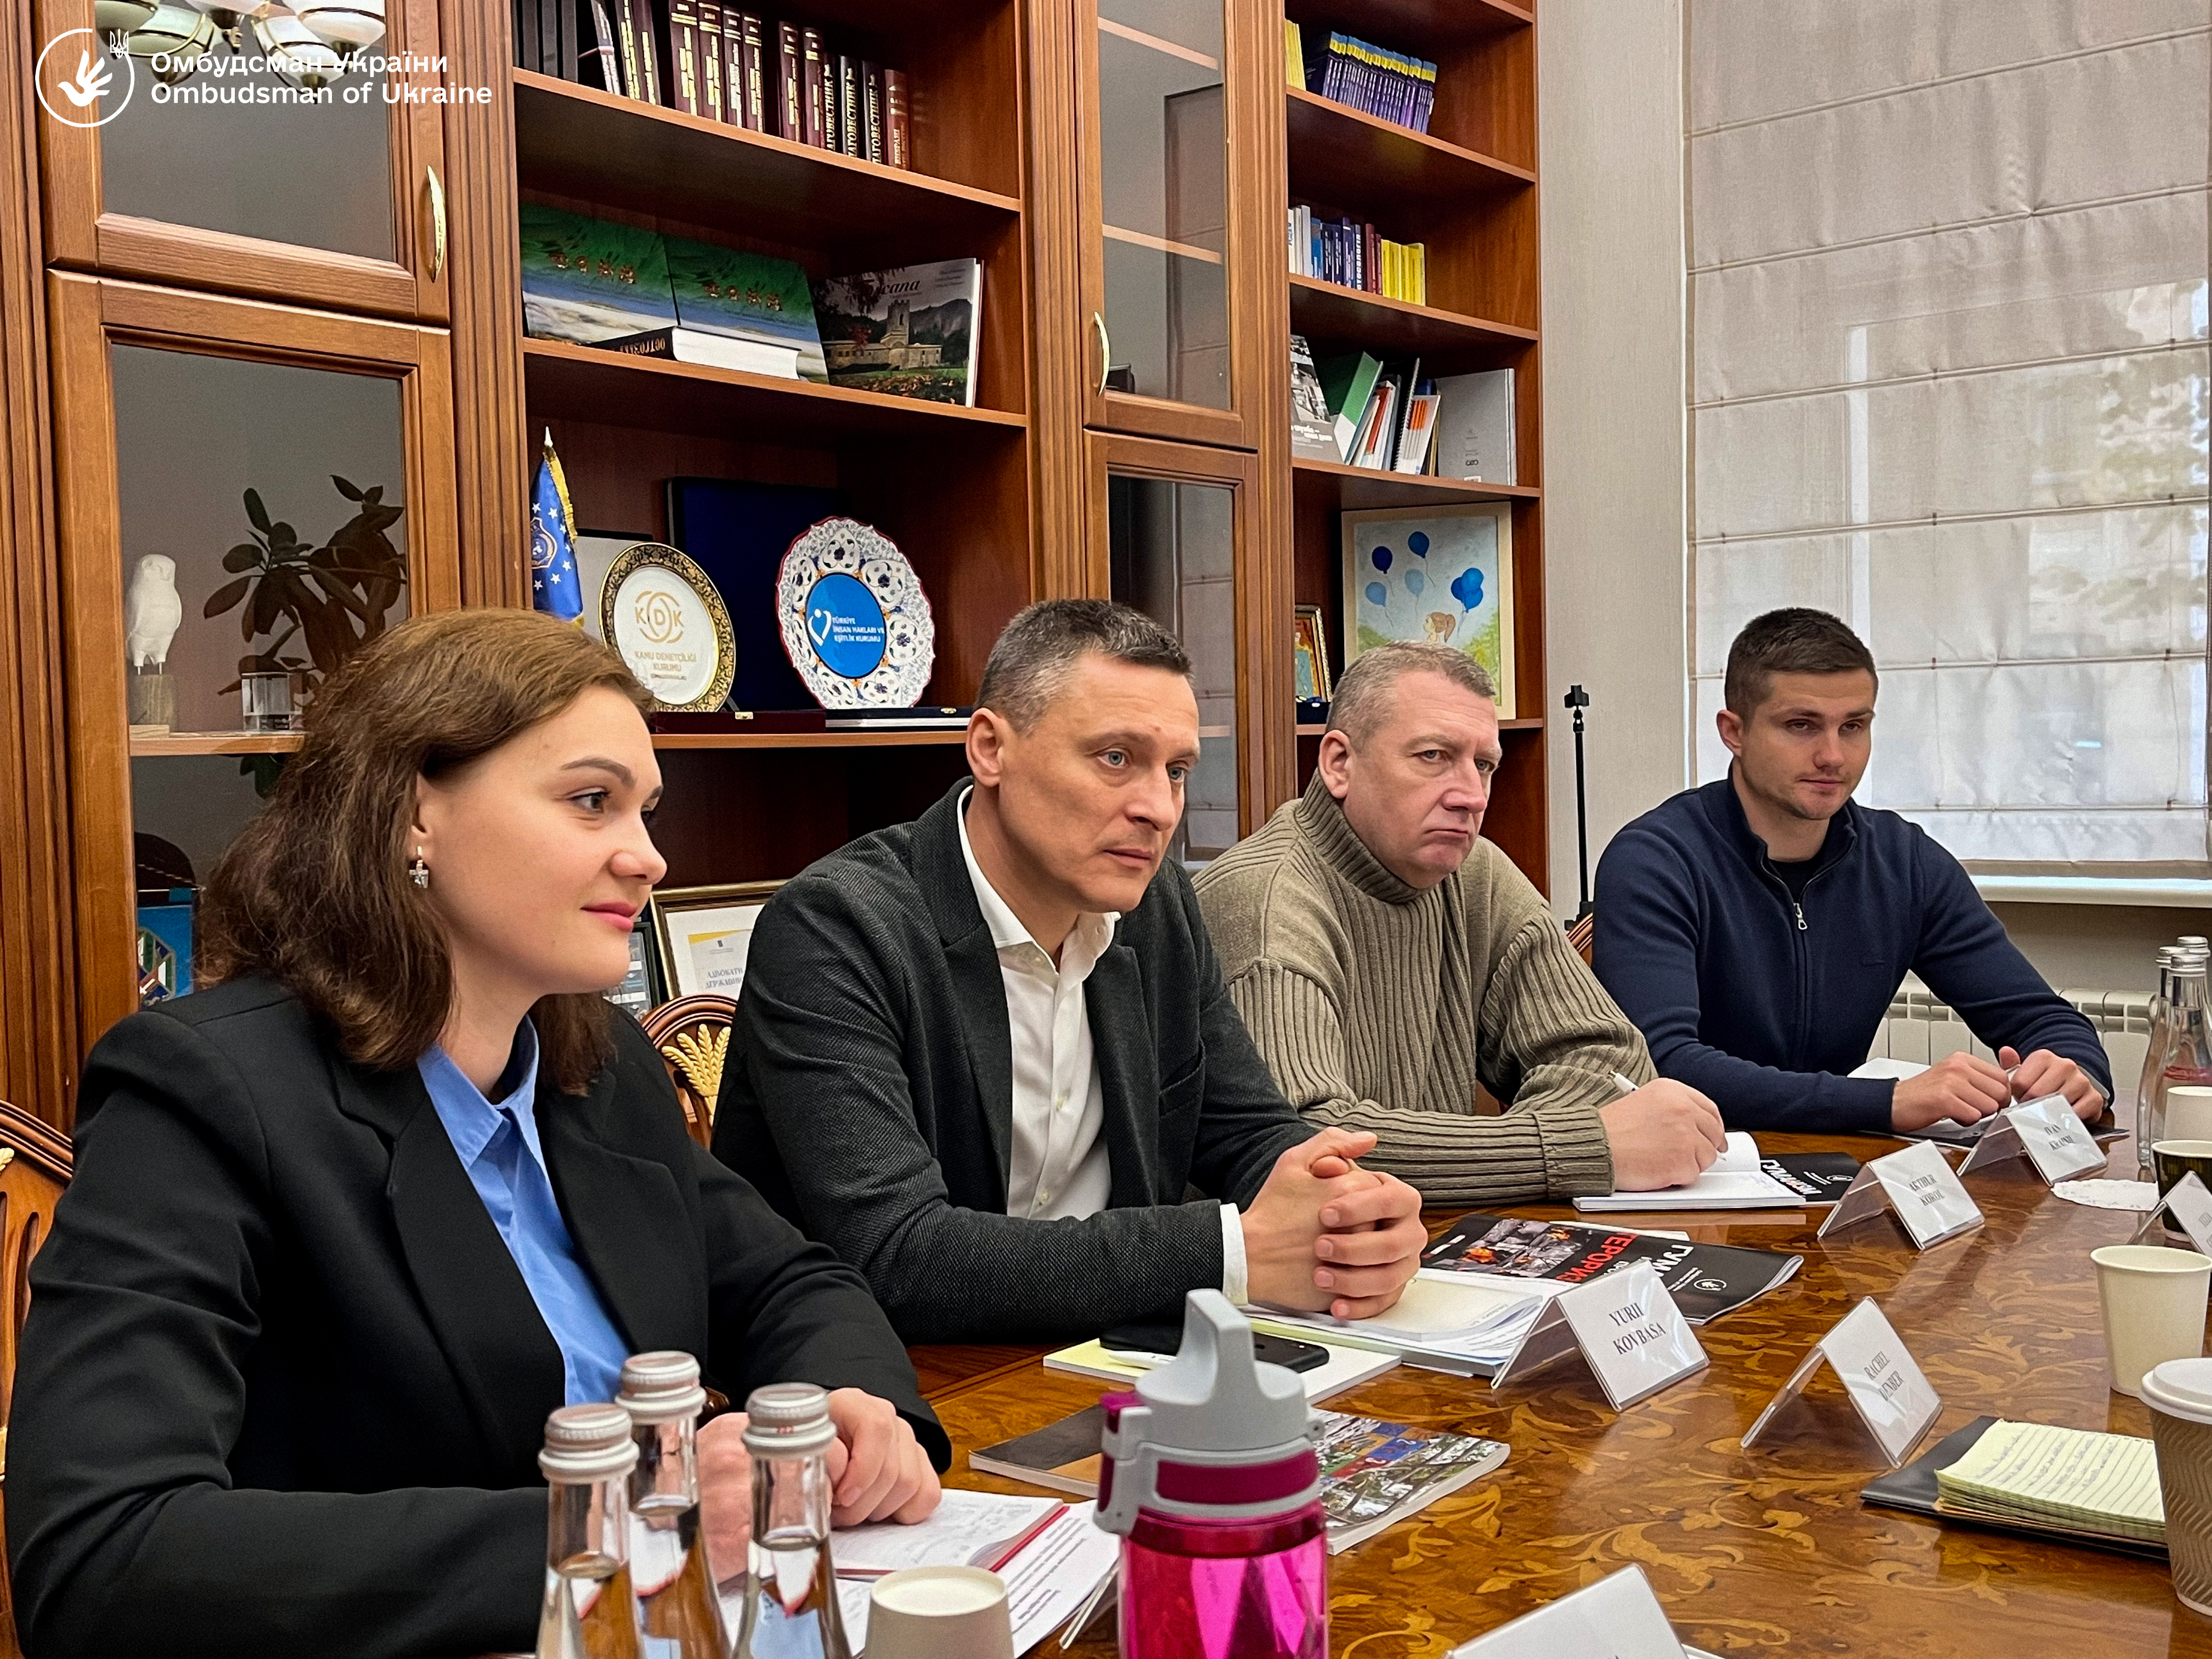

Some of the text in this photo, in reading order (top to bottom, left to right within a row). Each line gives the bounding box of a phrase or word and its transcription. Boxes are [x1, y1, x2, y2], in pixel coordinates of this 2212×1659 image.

[1909, 1174, 1937, 1192] ARTHUR
[1918, 1189, 1945, 1206] KOROL
[1609, 1302, 1644, 1327] YURII
[1613, 1322, 1666, 1355] KOVBASA
[1864, 1351, 1891, 1380] RACHEL
